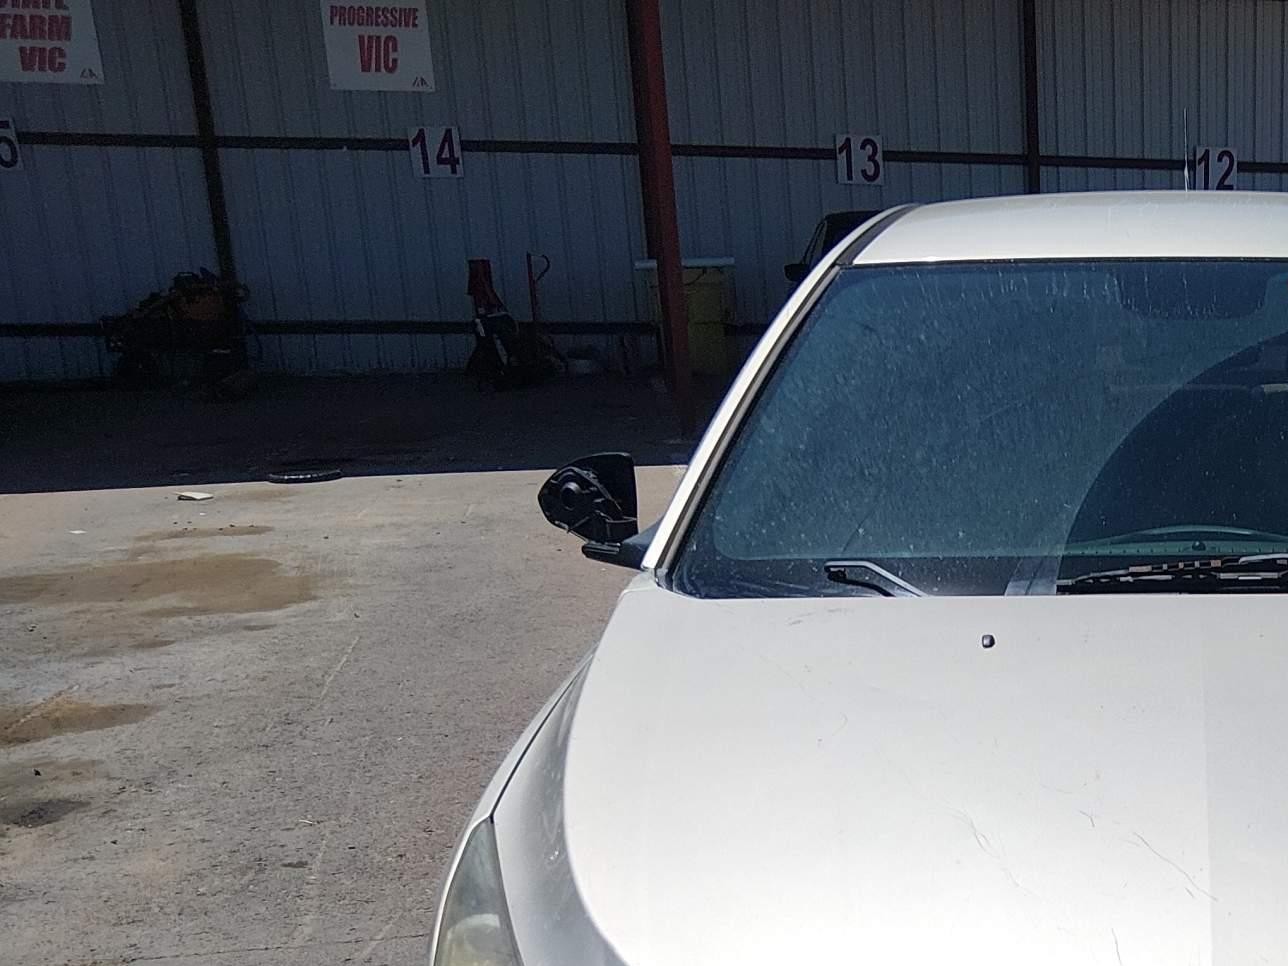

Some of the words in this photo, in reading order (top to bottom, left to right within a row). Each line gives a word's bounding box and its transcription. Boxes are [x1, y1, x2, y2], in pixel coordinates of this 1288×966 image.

[0, 14, 72, 41] FARM
[329, 5, 419, 28] PROGRESSIVE
[18, 46, 67, 73] VIC
[357, 34, 399, 74] VIC
[412, 128, 460, 175] 14
[838, 137, 880, 182] 13
[1197, 149, 1235, 190] 12
